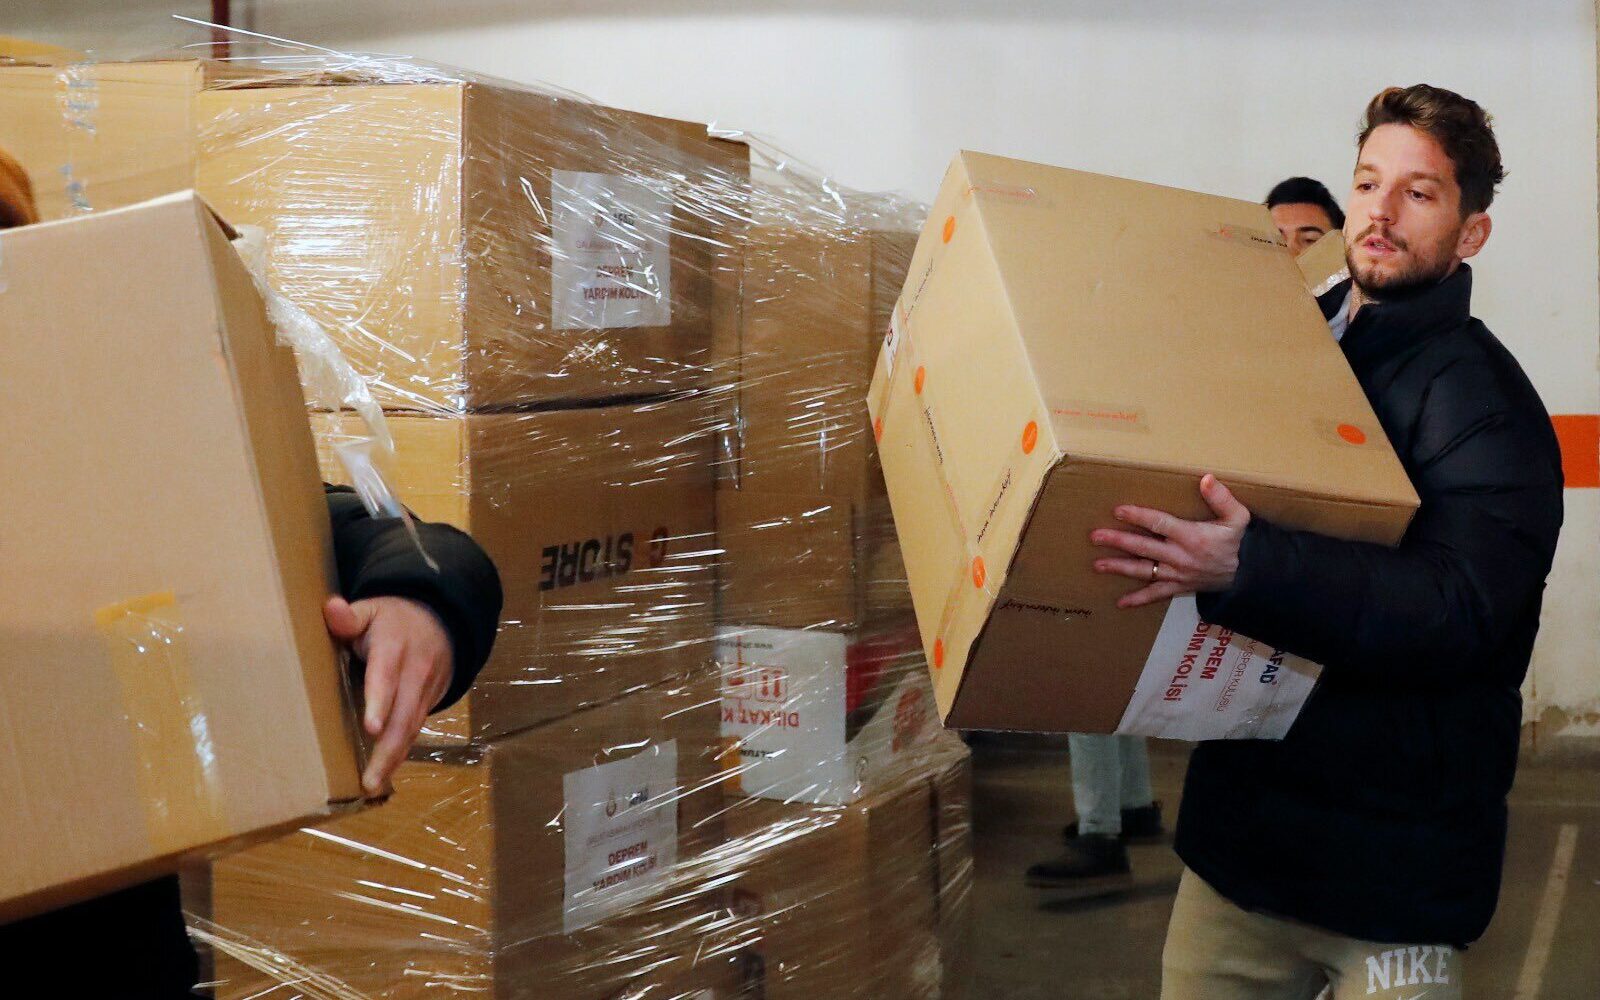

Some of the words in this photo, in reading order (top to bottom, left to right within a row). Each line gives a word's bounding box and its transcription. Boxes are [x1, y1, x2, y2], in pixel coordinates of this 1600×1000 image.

[538, 532, 634, 592] STORE
[1187, 620, 1211, 651] DIM
[1200, 627, 1232, 680] EPREM
[1163, 654, 1198, 701] KOLİSİ
[1365, 945, 1453, 995] NIKE
